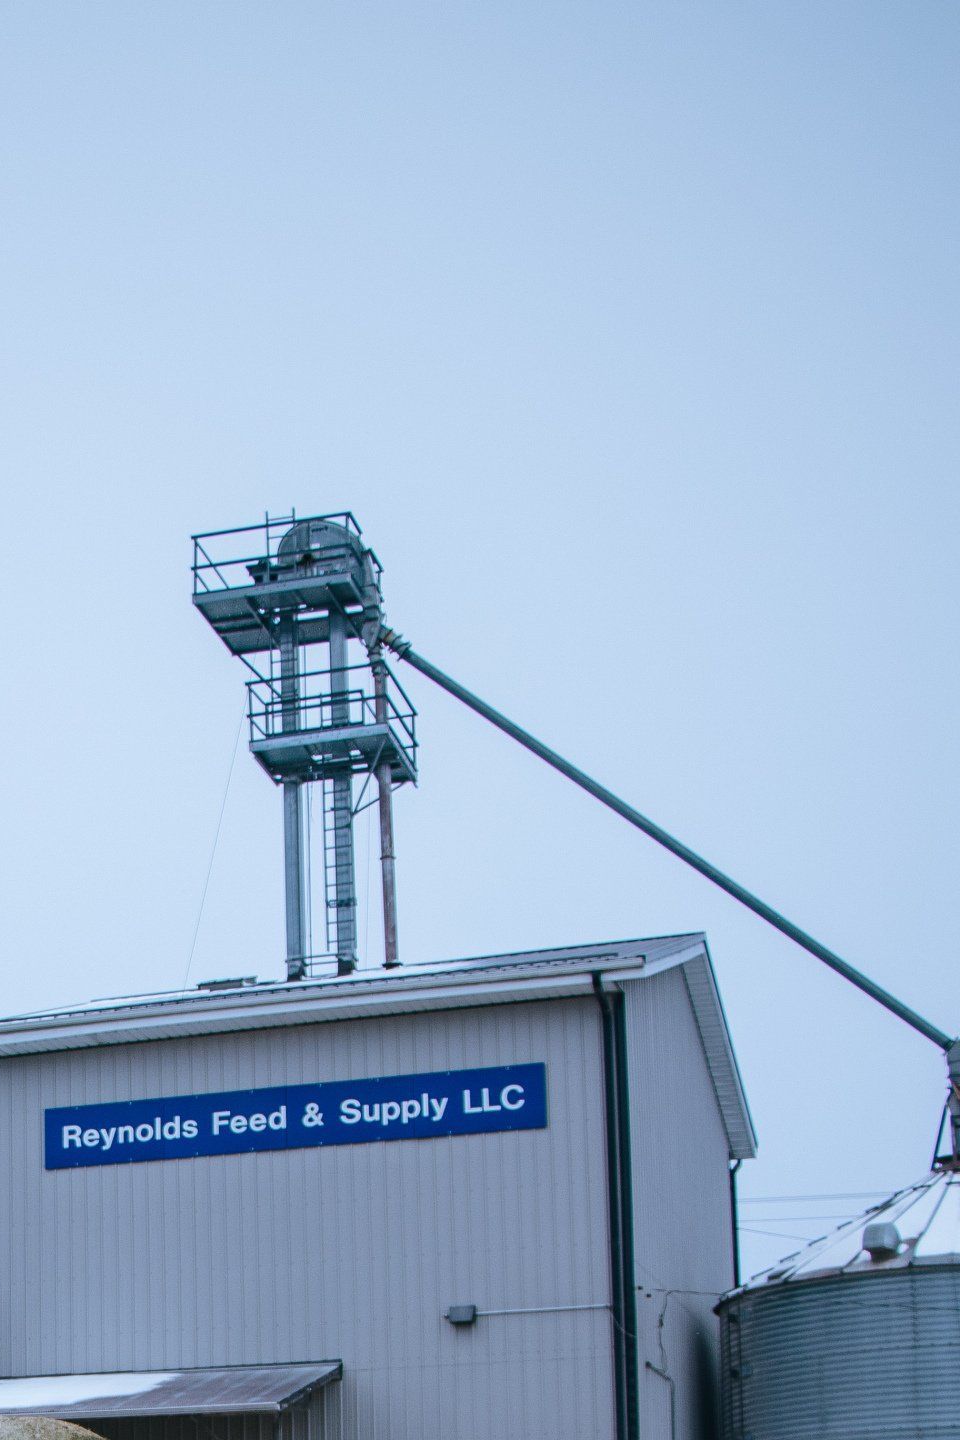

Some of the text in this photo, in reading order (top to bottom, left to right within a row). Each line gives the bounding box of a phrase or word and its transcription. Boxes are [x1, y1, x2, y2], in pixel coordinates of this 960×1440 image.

[62, 1083, 526, 1151] Reynolds Feed & Supply LLC
